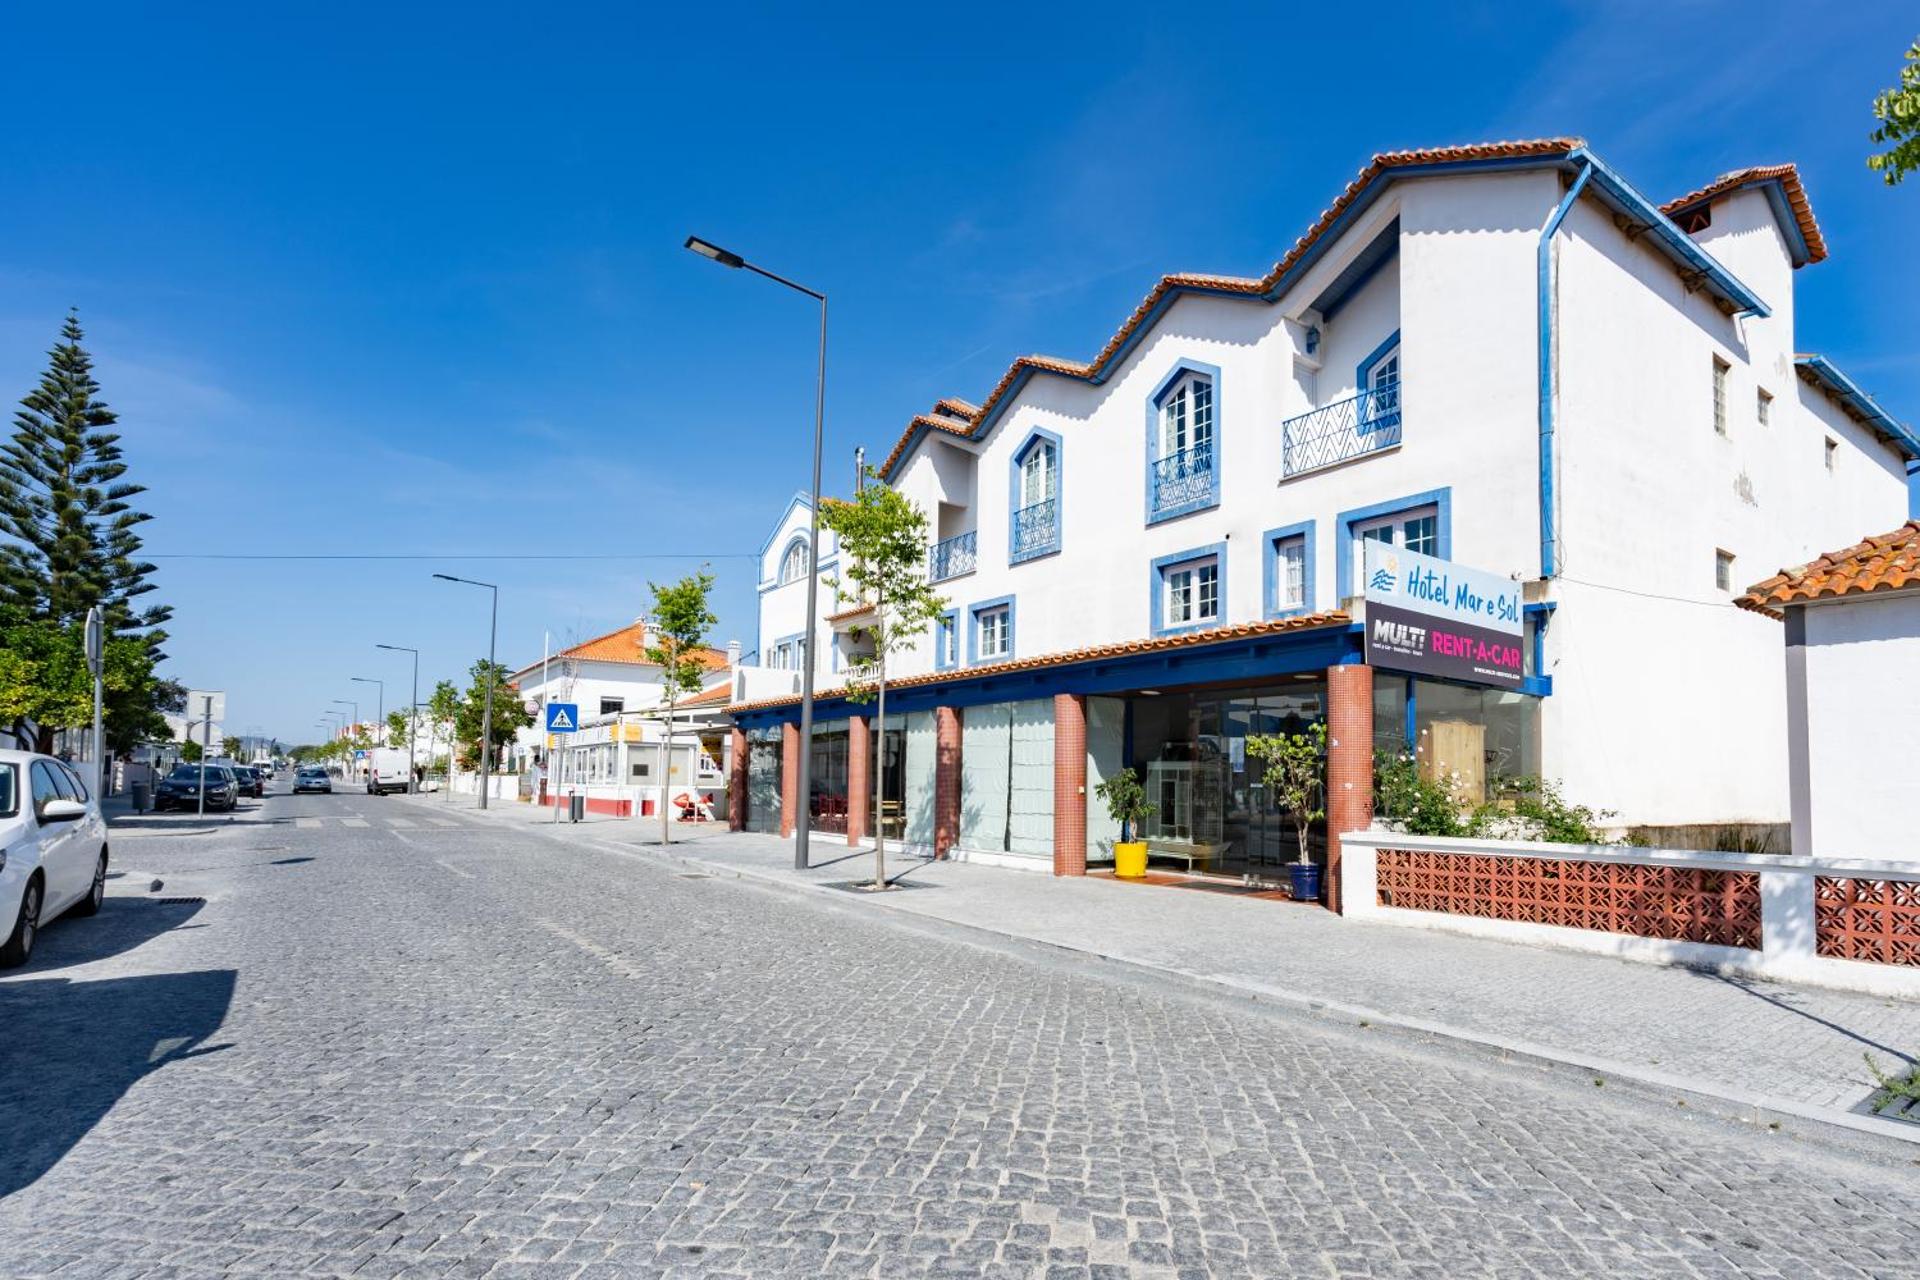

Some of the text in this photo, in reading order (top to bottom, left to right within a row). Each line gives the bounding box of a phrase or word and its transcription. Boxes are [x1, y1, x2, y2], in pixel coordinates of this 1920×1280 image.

[1407, 565, 1519, 623] Hotel Mar e Sol
